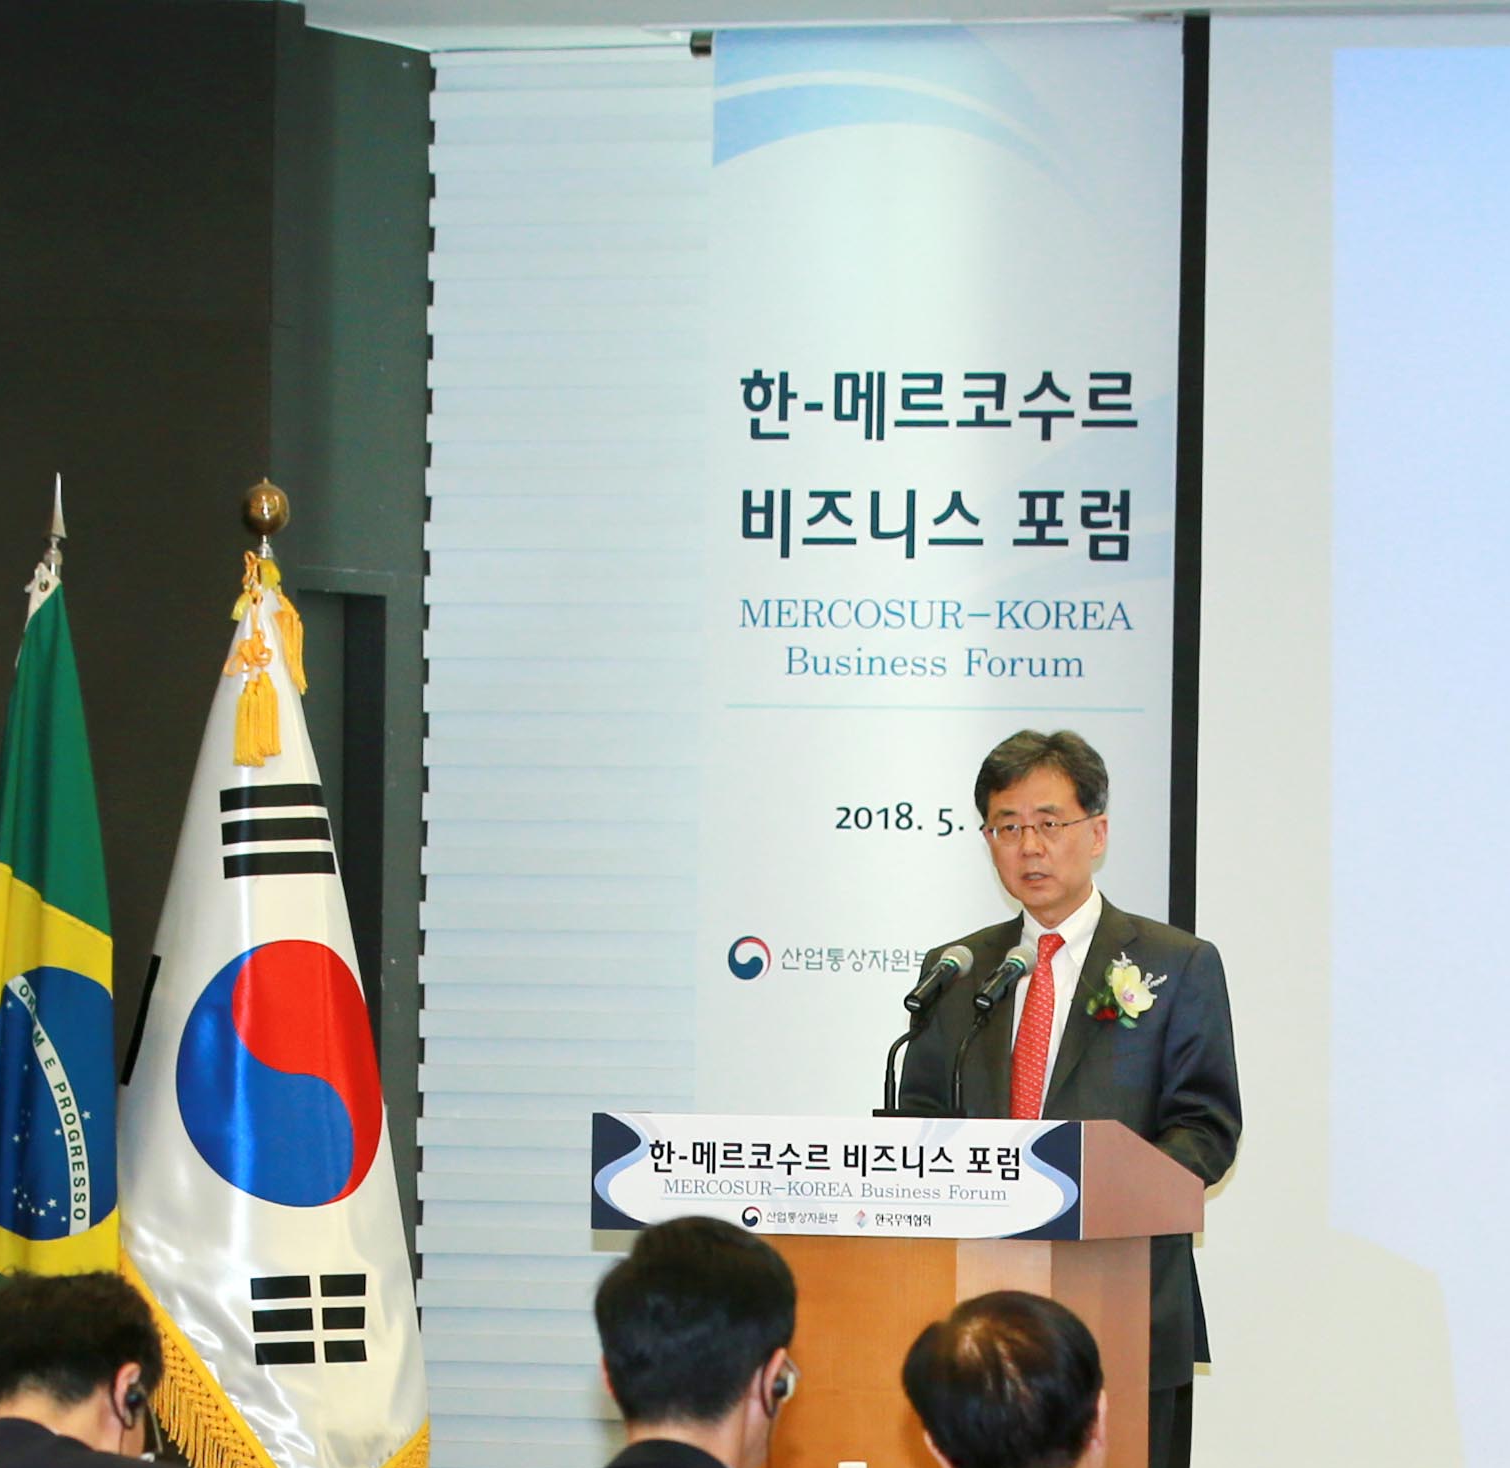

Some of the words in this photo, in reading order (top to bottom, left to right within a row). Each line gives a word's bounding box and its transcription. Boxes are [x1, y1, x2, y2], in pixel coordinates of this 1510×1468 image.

[740, 369, 1138, 441] 한-메르코수르
[742, 487, 984, 560] 비즈니스
[1012, 488, 1132, 562] 포럼
[785, 645, 947, 679] Business
[965, 647, 1085, 680] Forum
[835, 802, 923, 830] 2018.
[937, 808, 964, 836] 5.
[19, 984, 45, 1047] ORM
[44, 1058, 56, 1069] E
[54, 1082, 86, 1221] PROGRESSO
[649, 1139, 830, 1174] 한-메르코수르
[844, 1144, 955, 1179] 비즈니스
[967, 1146, 1021, 1181] 포럼
[861, 1183, 942, 1200] Business
[948, 1184, 1007, 1201] Forum
[766, 1211, 839, 1225] 산업통상자원부
[875, 1212, 932, 1228] 한국무역협회
